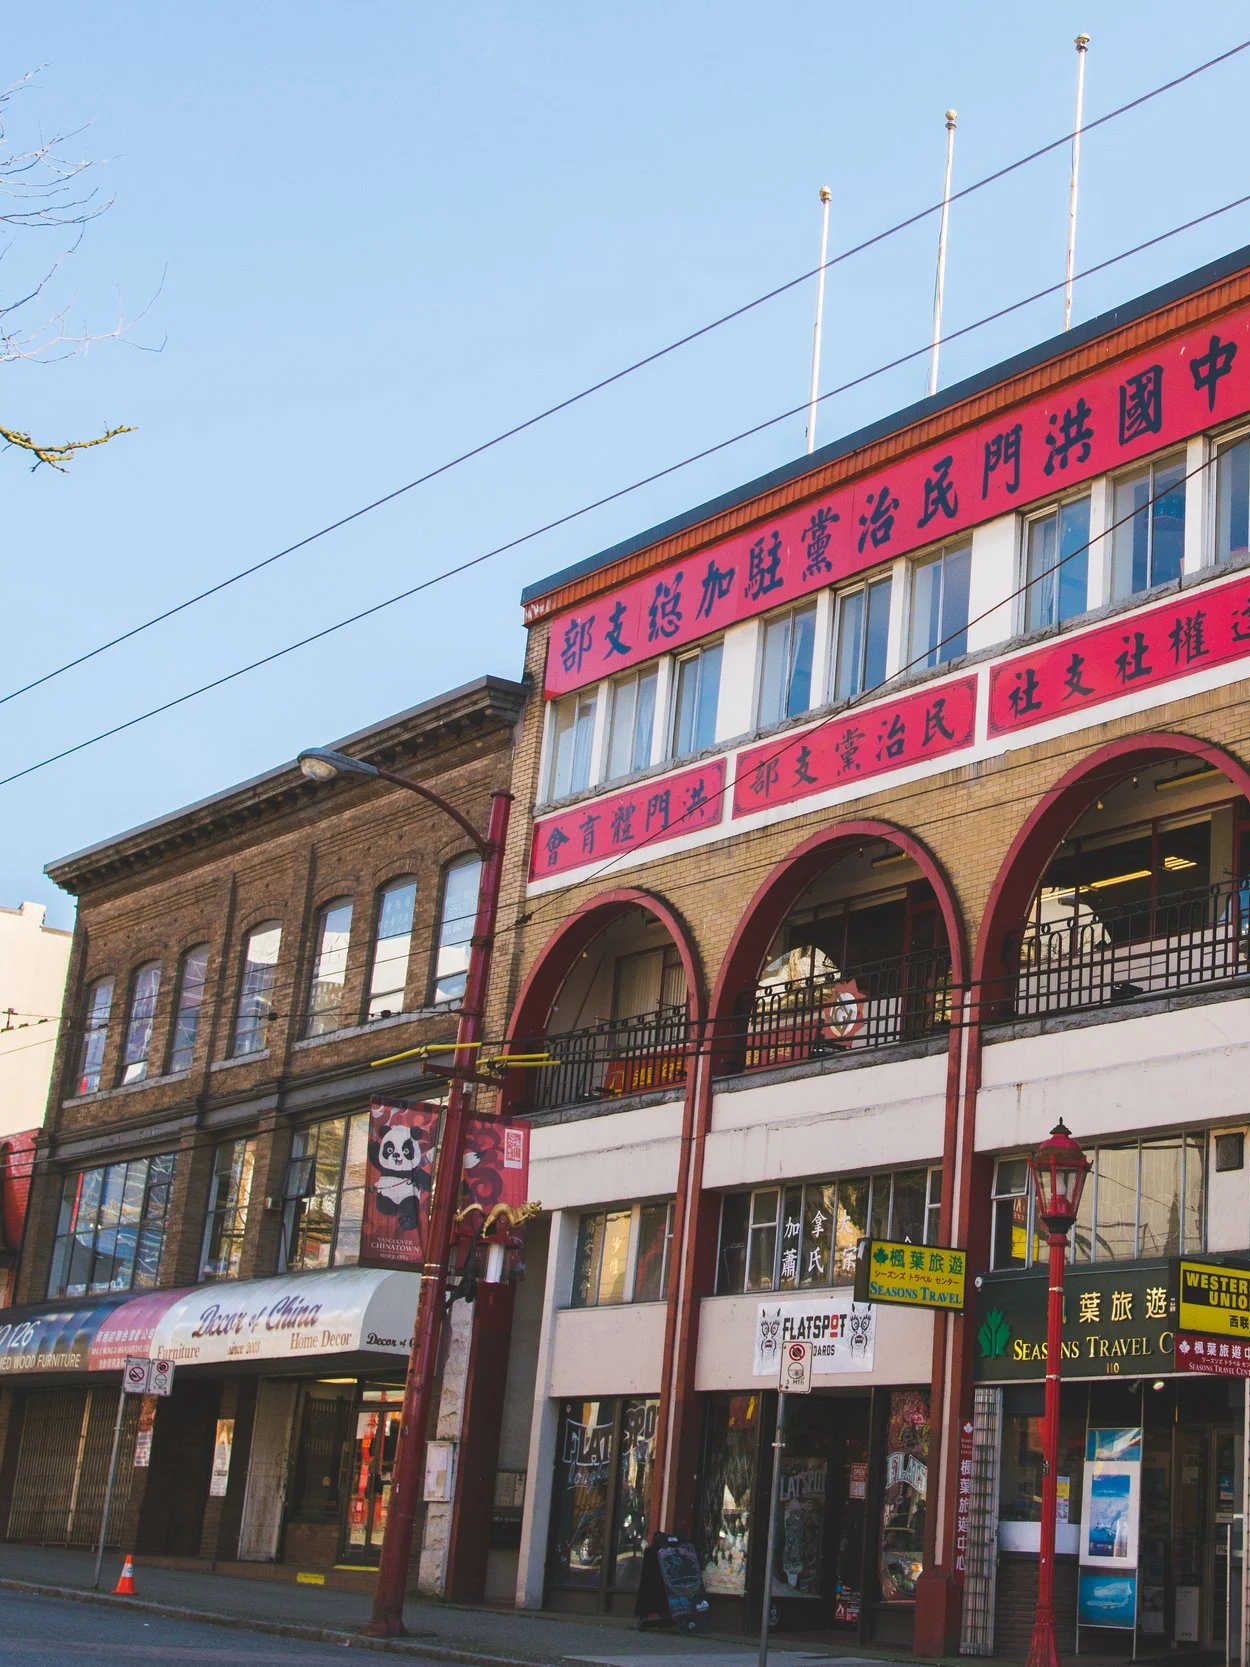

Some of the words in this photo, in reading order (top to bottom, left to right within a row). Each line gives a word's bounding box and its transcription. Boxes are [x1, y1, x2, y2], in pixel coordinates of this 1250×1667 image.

[750, 698, 957, 799] 民治黨支部
[784, 1209, 852, 1239] 加拿大
[371, 1242, 419, 1252] CHINATOWN
[376, 1236, 413, 1245] VANCOUVER
[890, 1248, 963, 1275] 楓葉旅遊
[909, 1274, 932, 1283] トラベル
[936, 1277, 959, 1285] センター
[870, 1281, 917, 1299] SEASONS
[921, 1287, 961, 1304] TRAVEL
[192, 1303, 247, 1338] Decor
[249, 1306, 267, 1334] of
[265, 1295, 322, 1331] China
[1063, 1287, 1167, 1324] 葉旅遊
[782, 1314, 847, 1340] FLATSPOT
[290, 1332, 318, 1349] Home
[321, 1329, 352, 1348] Decor
[367, 1332, 397, 1347] Decor
[1013, 1339, 1079, 1361] SEASNS
[1087, 1335, 1151, 1358] TRAVEL
[14, 1354, 36, 1368] WOOD
[36, 1353, 81, 1369] FURNITURE
[157, 1343, 200, 1360] Furniture
[1106, 1363, 1120, 1374] 110
[1189, 1361, 1213, 1373] SEASONS
[1214, 1364, 1235, 1375] TRAVEL
[886, 1451, 928, 1493] FLATS
[780, 1469, 827, 1500] LATSPOT
